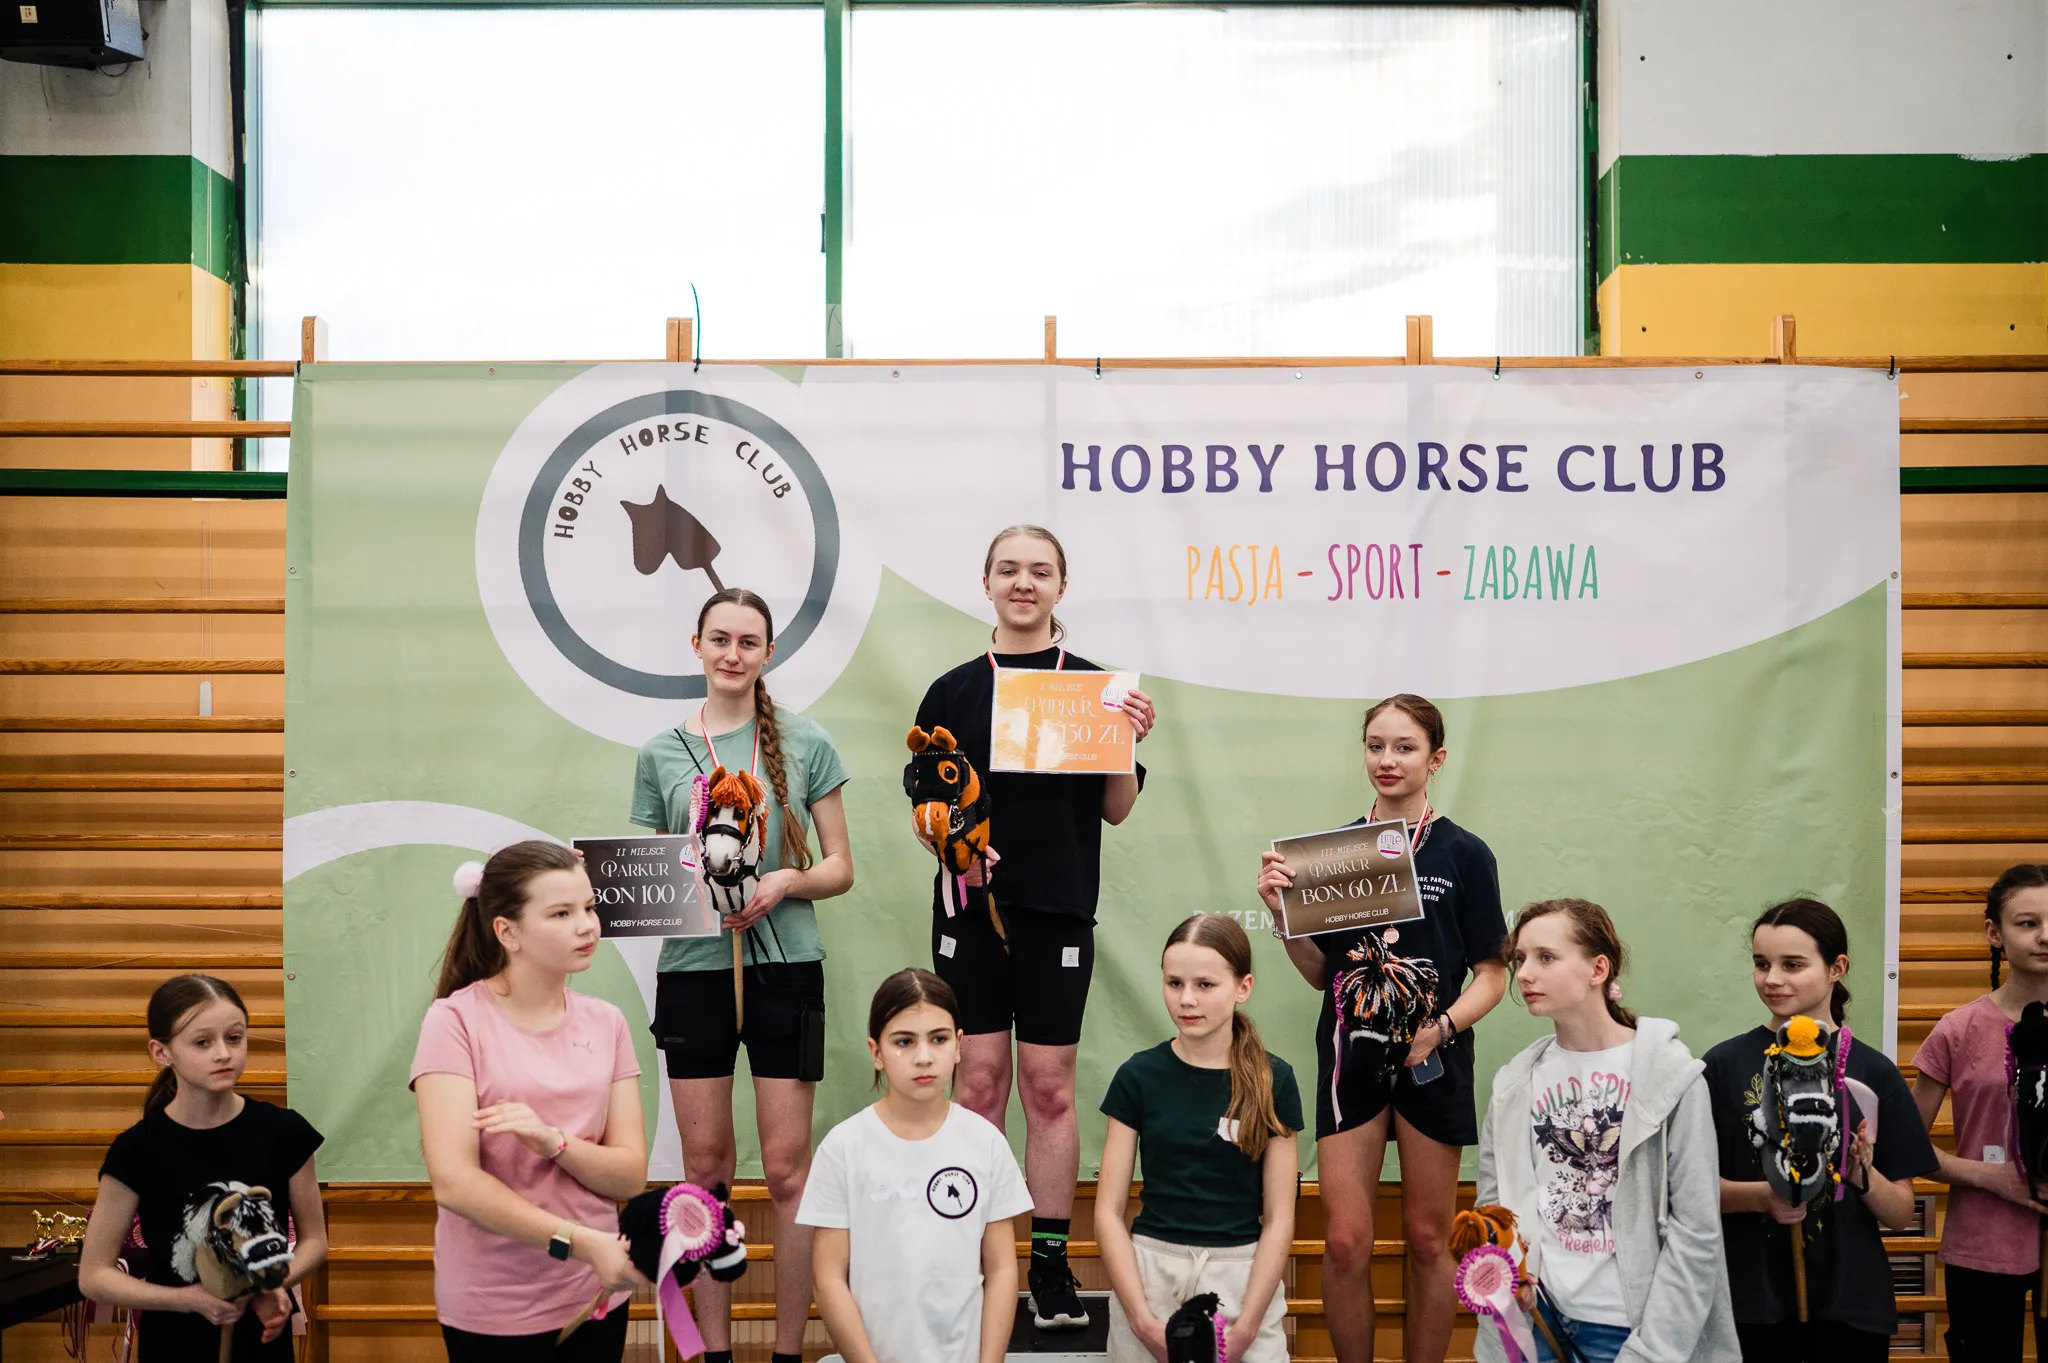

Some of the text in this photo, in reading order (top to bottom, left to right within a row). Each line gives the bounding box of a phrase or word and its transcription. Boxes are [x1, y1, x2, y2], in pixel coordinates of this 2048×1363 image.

[553, 421, 792, 539] HOBBY HORSE CLUB
[1061, 441, 1727, 494] HOBBY HORSE CLUB
[1187, 544, 1283, 606] PASJA
[1327, 543, 1424, 602] SPORT
[1463, 544, 1599, 602] ZABAWA
[630, 847, 666, 856] MIEJSCE
[642, 883, 676, 905] 100
[1301, 873, 1406, 905] BON 60 ZŁ
[636, 919, 662, 927] HORSE
[663, 918, 683, 926] CLUB
[1325, 908, 1389, 924] HOBBY HORSE CLUB
[1531, 1076, 1582, 1123] WILD
